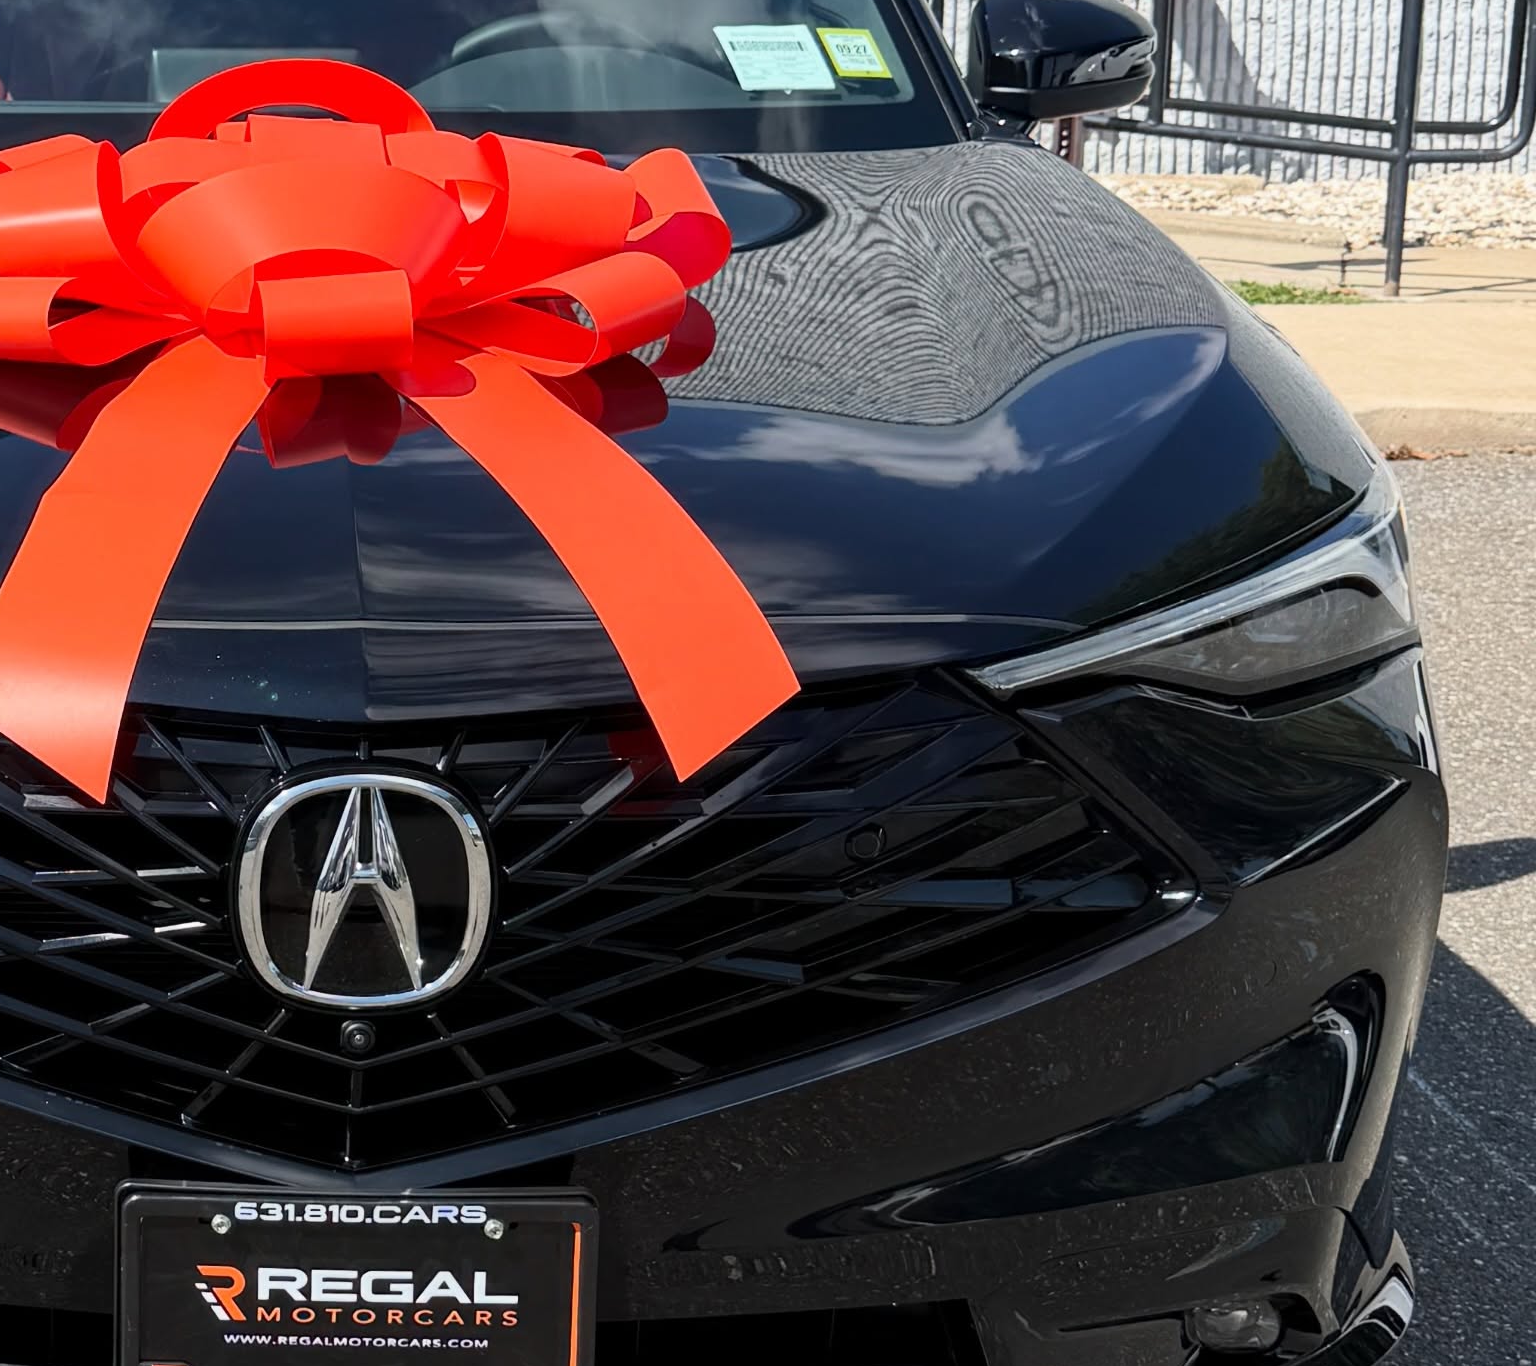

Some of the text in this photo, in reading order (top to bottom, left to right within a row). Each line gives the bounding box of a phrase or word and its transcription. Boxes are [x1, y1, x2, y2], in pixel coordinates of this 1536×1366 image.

[234, 1201, 488, 1224] 631.810.CARS
[257, 1267, 519, 1304] REGAL
[257, 1307, 518, 1327] MOTORCARS
[224, 1334, 489, 1348] WWW.REGALMOTORCARS.COM
